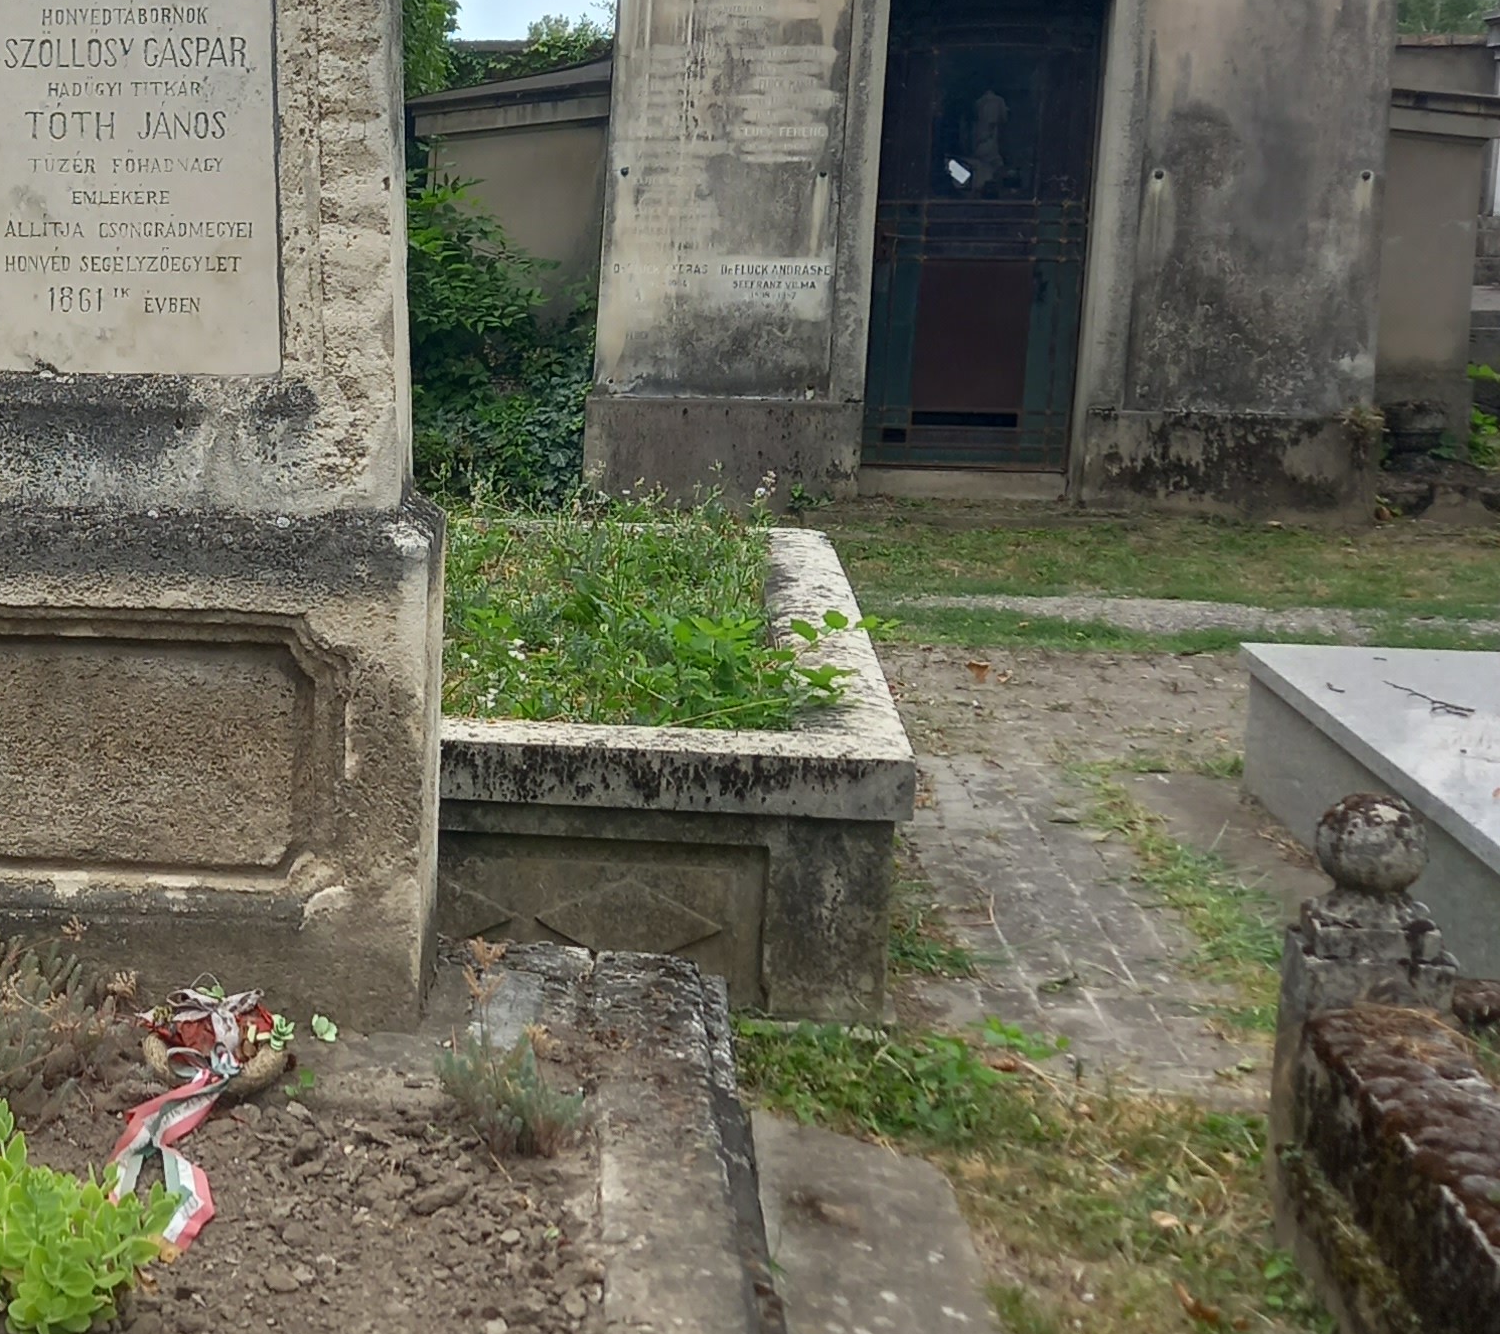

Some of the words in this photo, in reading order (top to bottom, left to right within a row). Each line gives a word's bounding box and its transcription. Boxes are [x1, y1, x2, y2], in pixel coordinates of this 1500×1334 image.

[41, 0, 209, 26] HONVÉDTÁBORNOK
[144, 27, 247, 69] GÁSPÁR
[130, 74, 202, 97] TITKÁR
[24, 102, 115, 141] TÓTH
[137, 100, 227, 140] JÁNOS
[71, 183, 171, 205] EMLÉKÉRE
[4, 213, 85, 238] ÁLLÍTJA
[99, 213, 253, 239] CSONGRÁDMEGYEI
[4, 246, 71, 273] HONVÉD
[734, 264, 769, 276] FLUCK
[47, 285, 104, 314] 1861
[113, 287, 131, 298] IK
[144, 288, 201, 314] ÉVBEN
